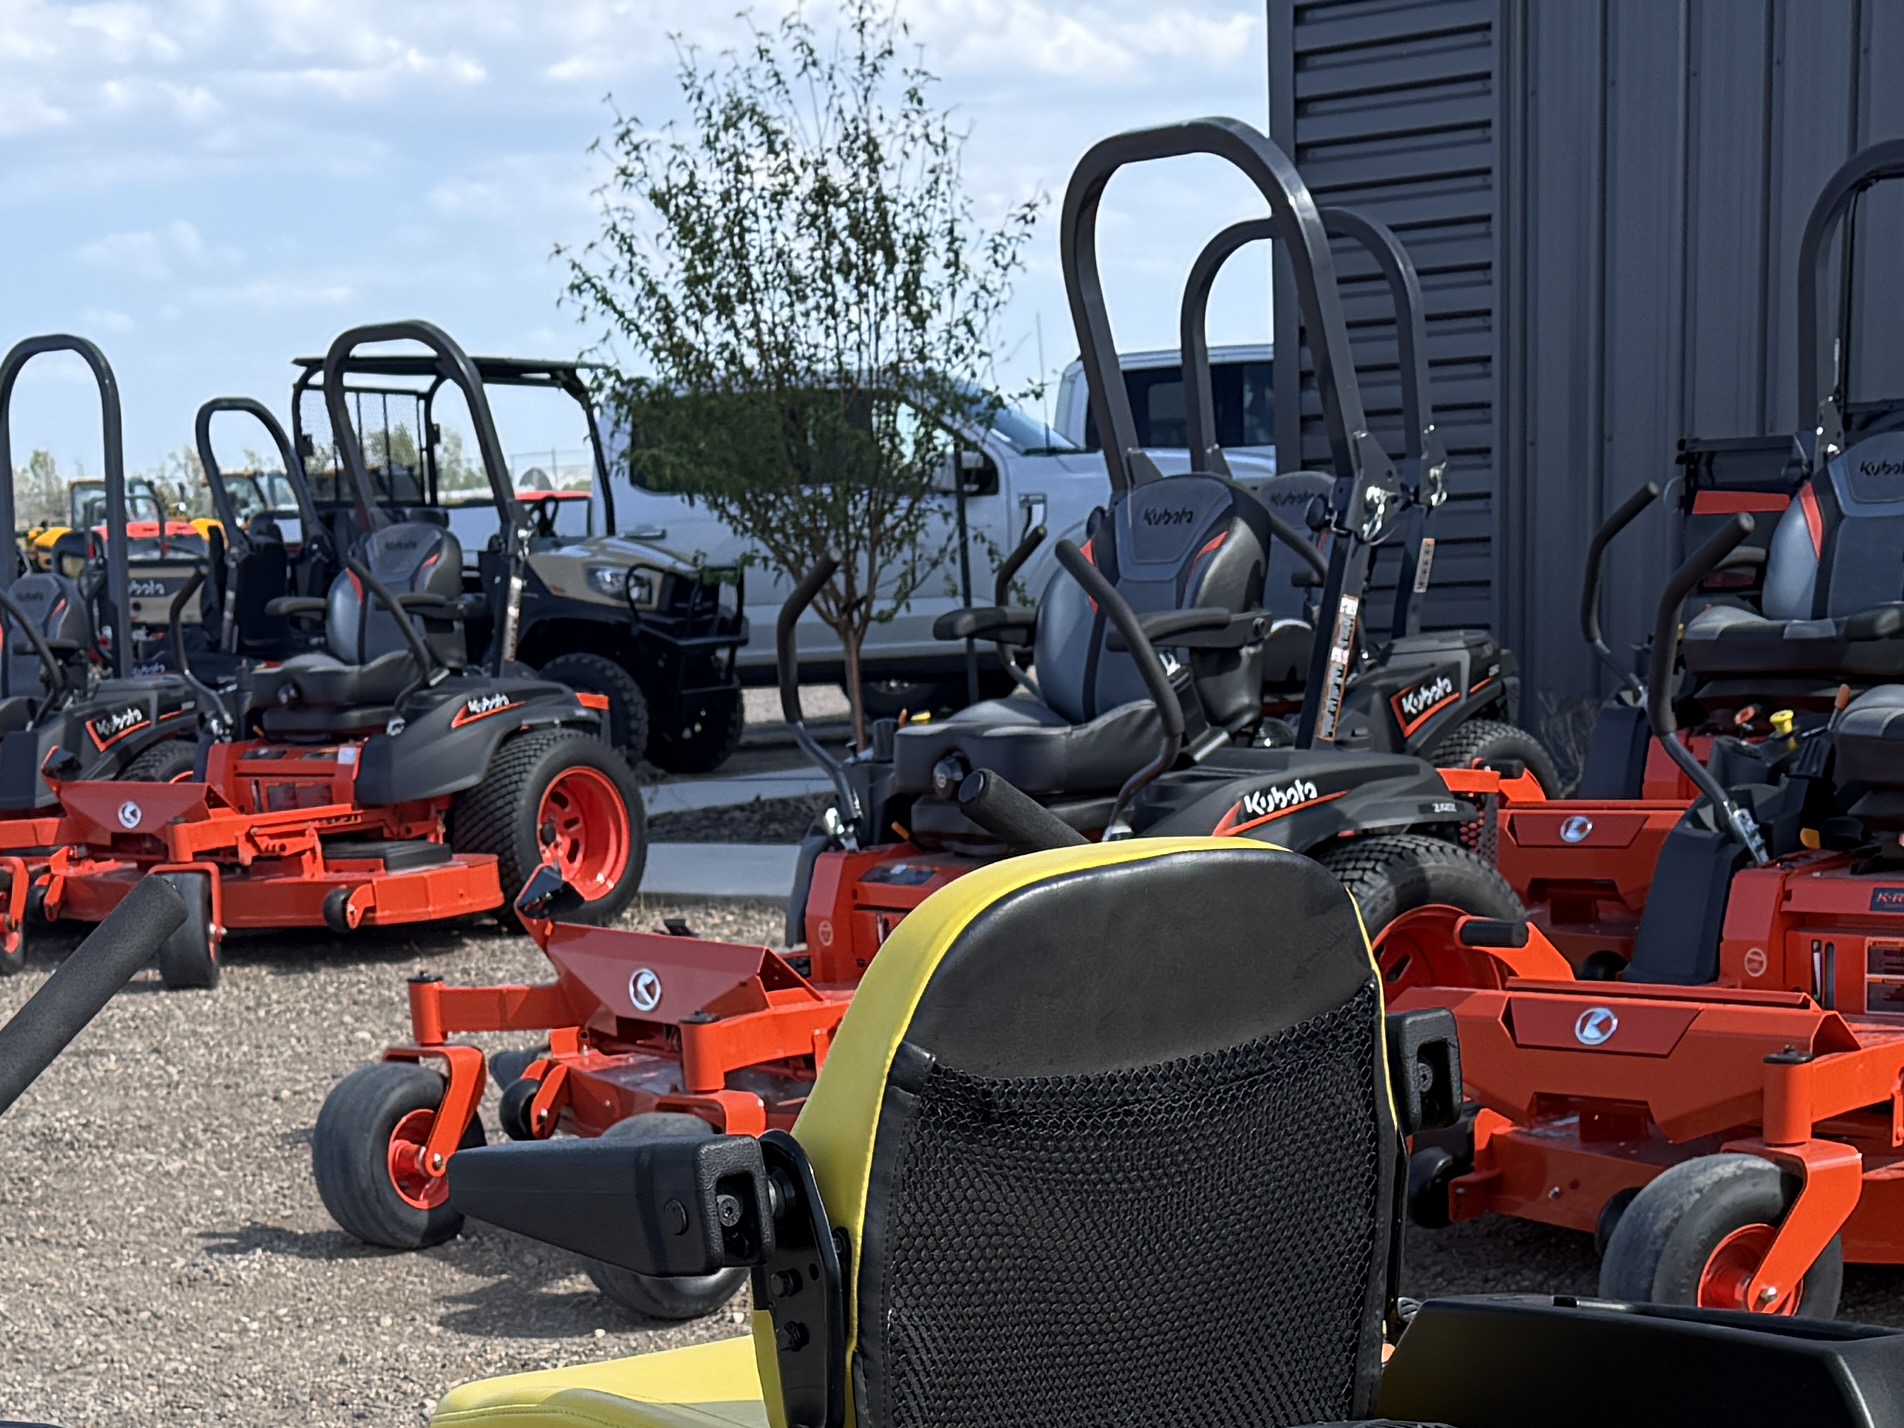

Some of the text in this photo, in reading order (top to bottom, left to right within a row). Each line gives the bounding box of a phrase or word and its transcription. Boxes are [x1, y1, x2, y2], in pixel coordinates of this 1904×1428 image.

[1143, 507, 1194, 527] Kubota
[1401, 677, 1452, 714] Kubota
[1243, 779, 1318, 815] Kubota
